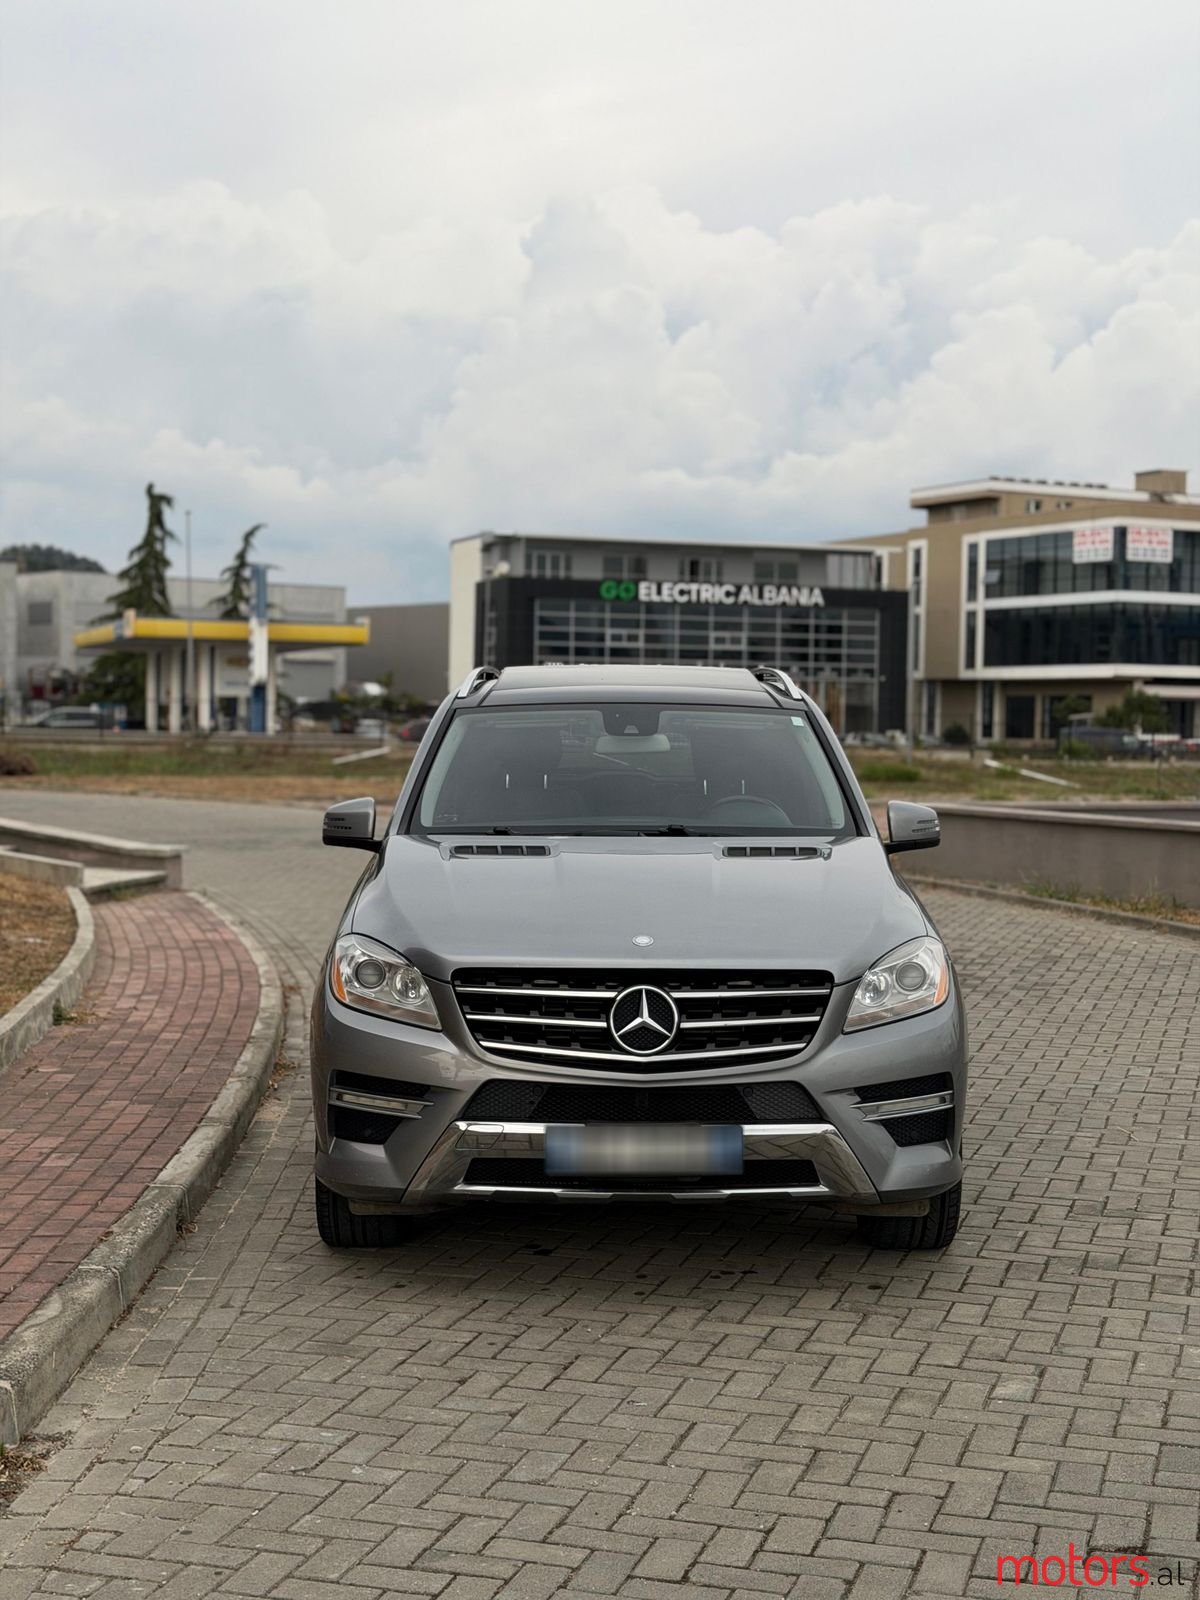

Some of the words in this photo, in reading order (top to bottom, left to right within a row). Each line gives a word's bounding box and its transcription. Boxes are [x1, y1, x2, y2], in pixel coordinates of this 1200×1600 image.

[600, 580, 636, 600] GO
[638, 581, 736, 604] ELECTRIC
[737, 585, 825, 606] ALBANIA
